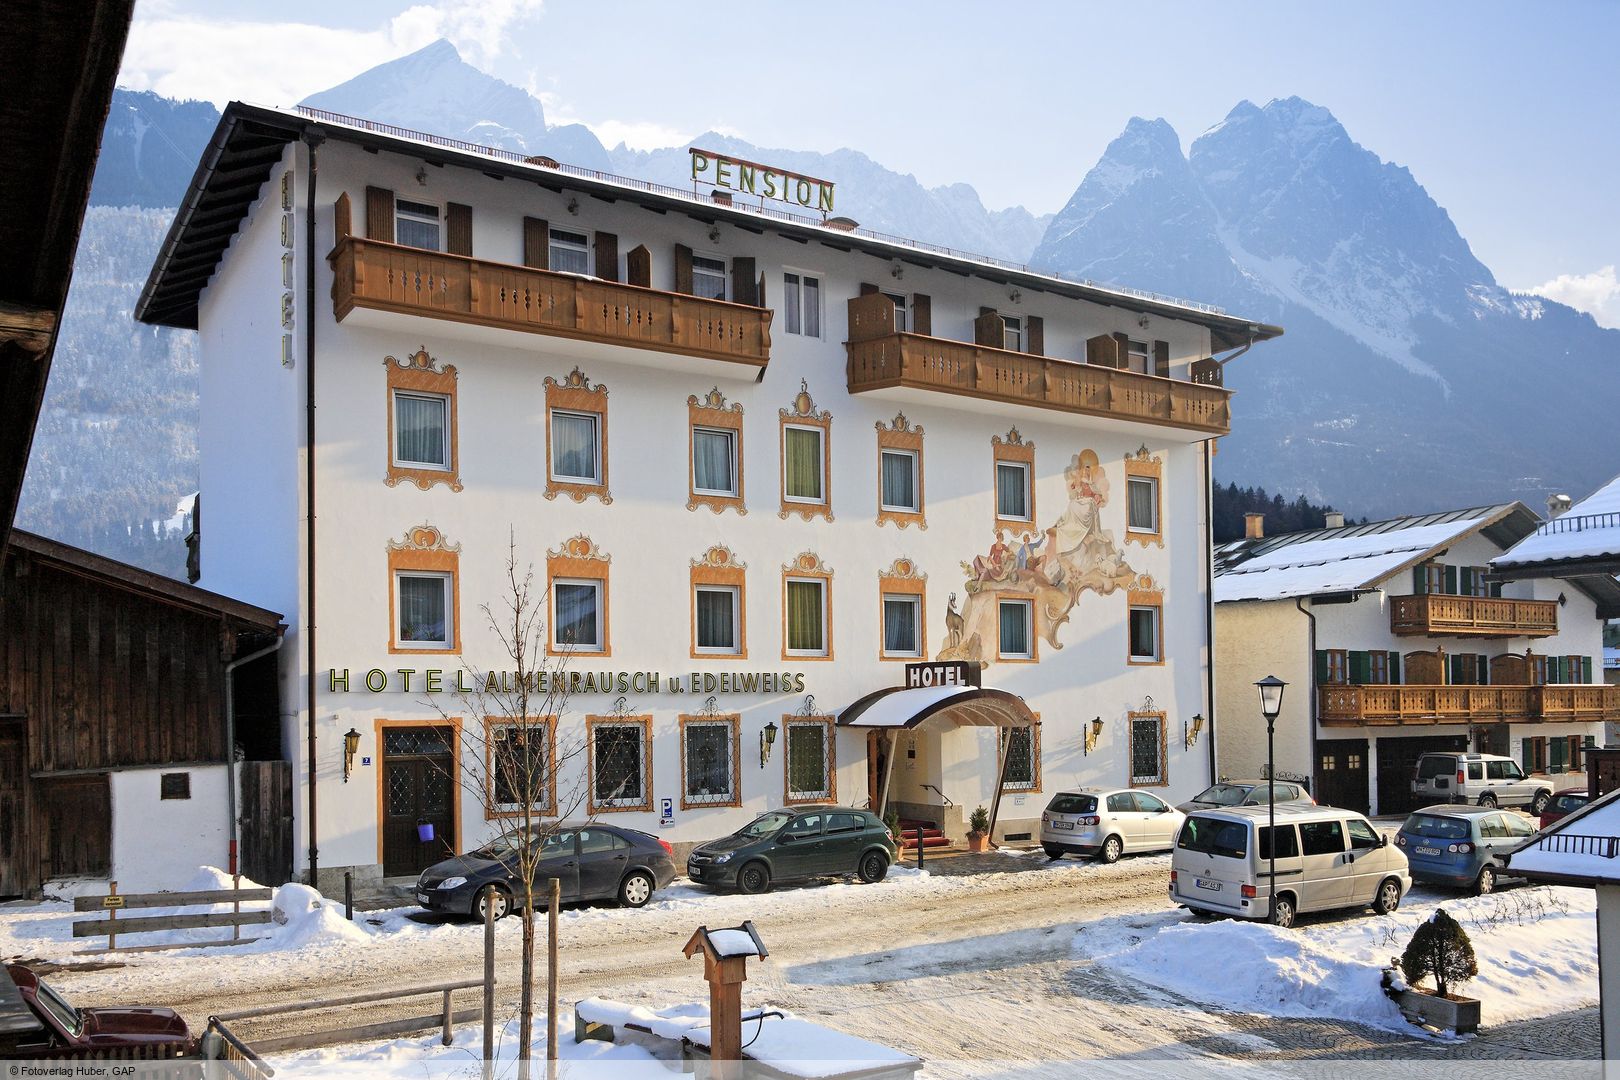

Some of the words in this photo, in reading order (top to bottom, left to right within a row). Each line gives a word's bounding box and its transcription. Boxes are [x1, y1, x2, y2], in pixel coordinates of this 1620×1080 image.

[692, 152, 835, 212] PENSION
[329, 668, 473, 693] HOTEL
[484, 670, 660, 694] ALMENRAUSCH
[691, 672, 805, 693] EDELWEISS
[910, 666, 966, 687] HOTEL
